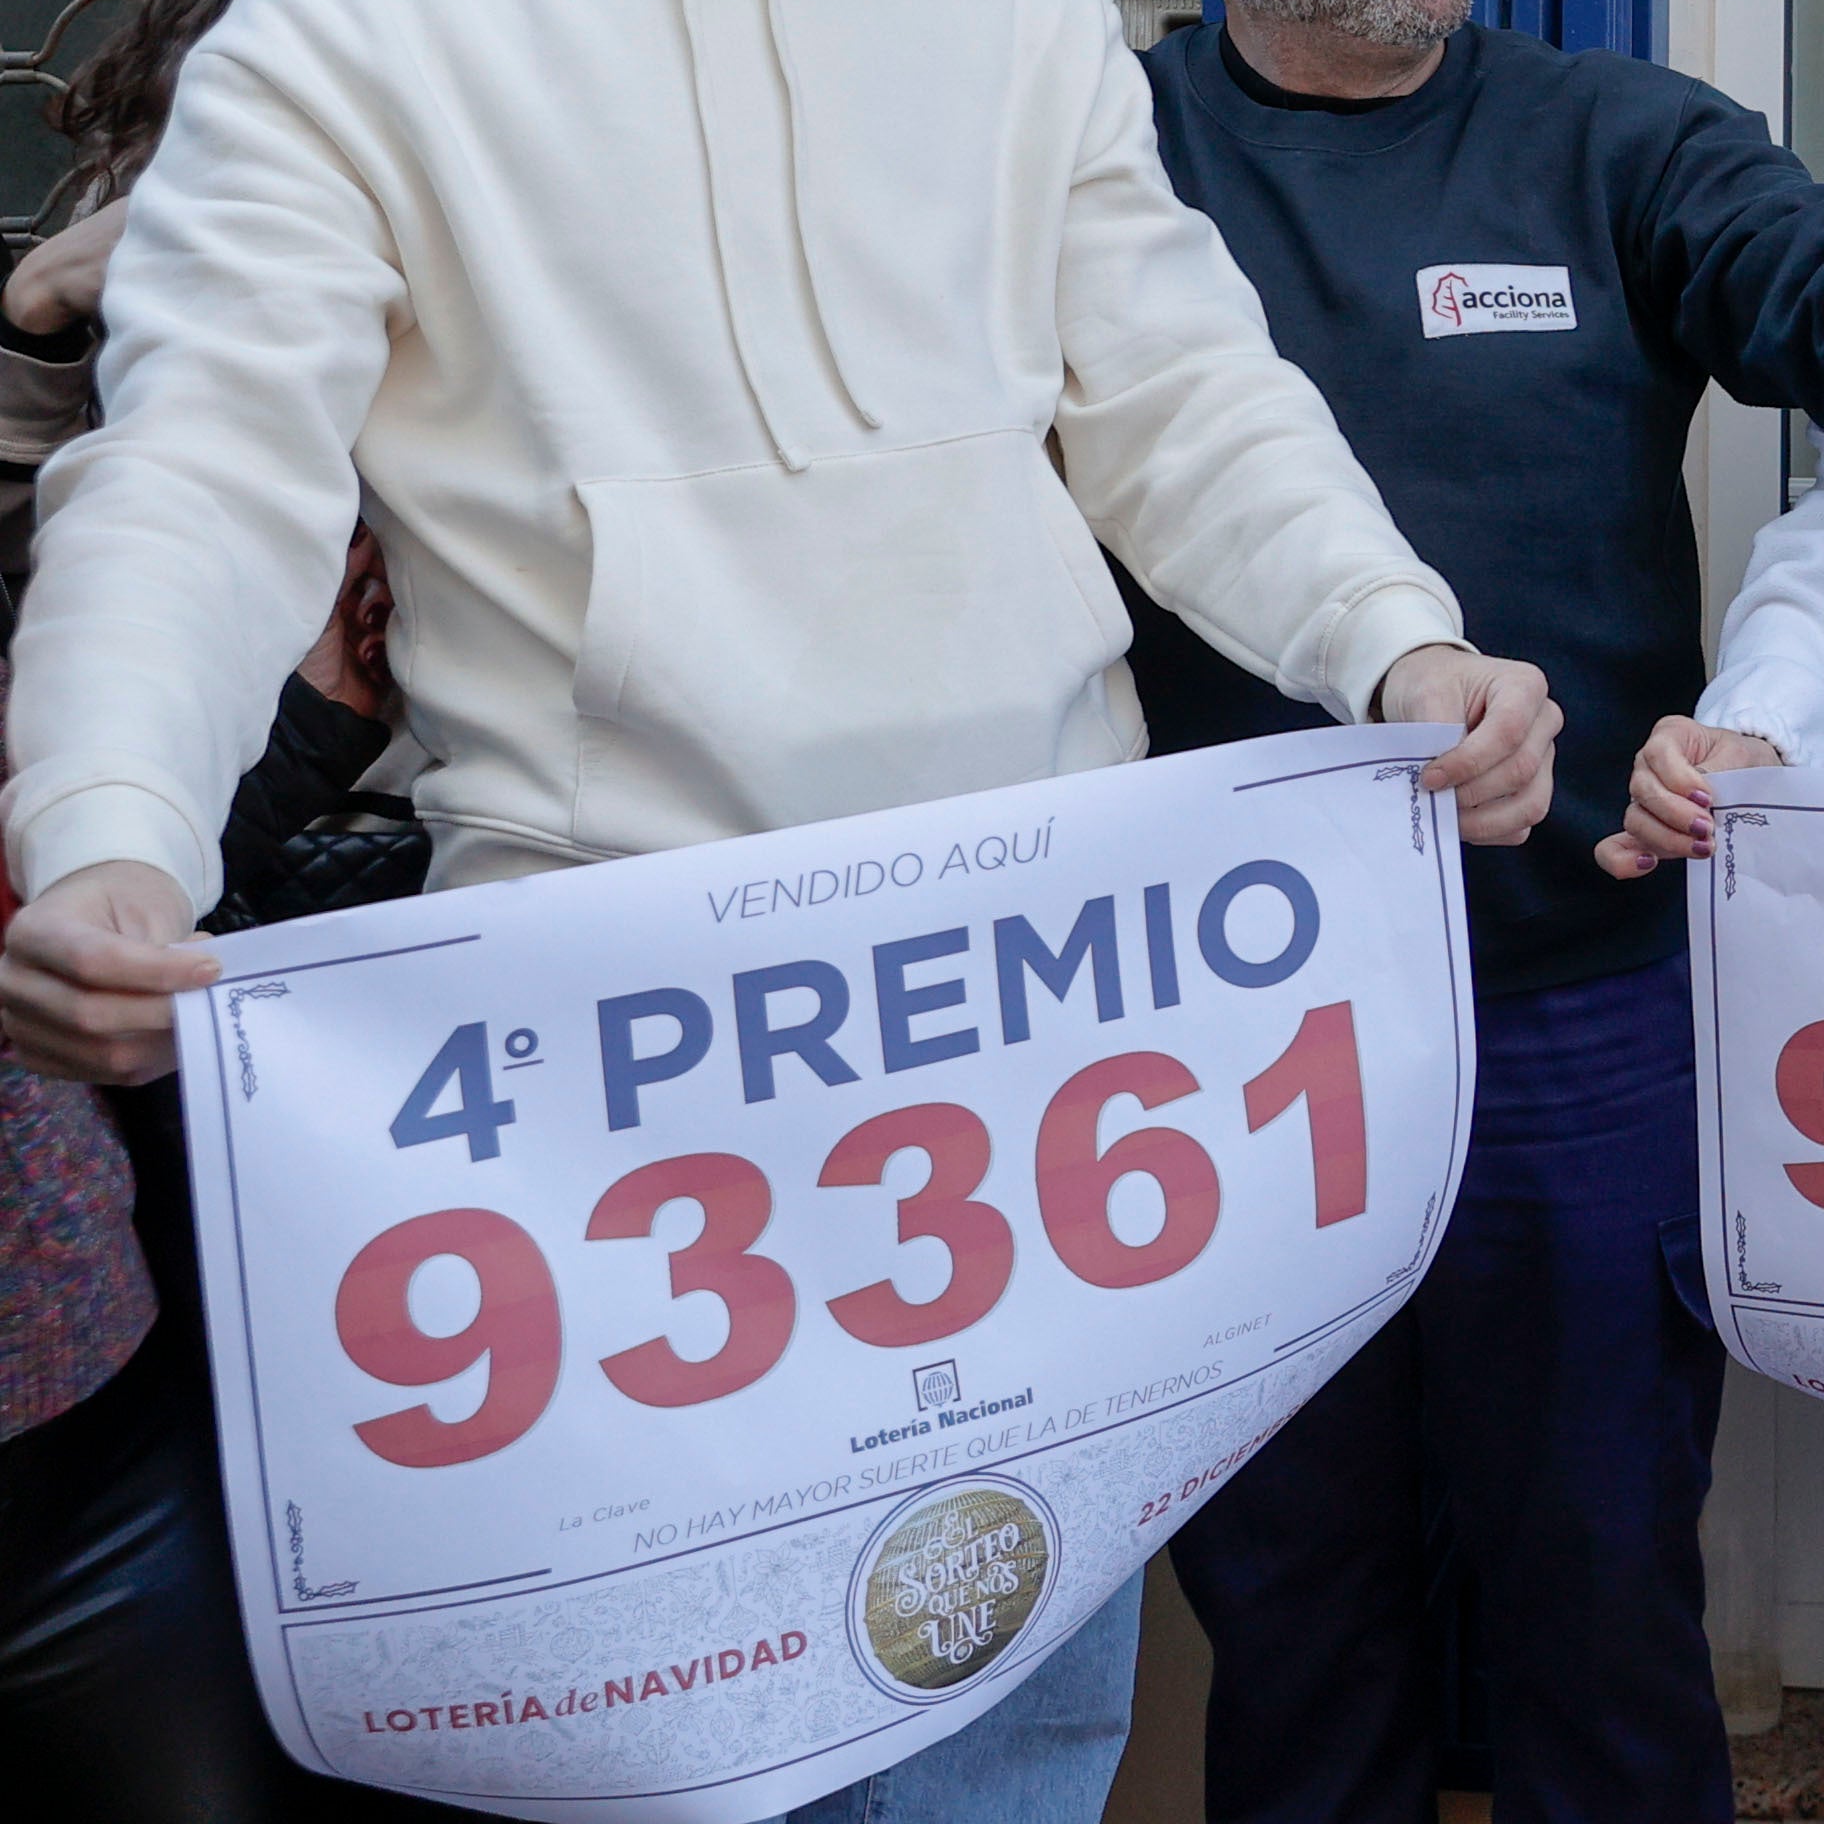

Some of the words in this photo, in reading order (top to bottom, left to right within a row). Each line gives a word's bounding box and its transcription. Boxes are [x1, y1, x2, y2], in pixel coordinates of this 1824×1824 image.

[1462, 285, 1567, 309] acciona
[1493, 310, 1529, 321] Facility
[1531, 309, 1570, 320] Services
[705, 850, 925, 926] VENDIDO
[936, 816, 1058, 884] AQUÍ
[596, 858, 1323, 1133] PREMIO
[332, 999, 1370, 1471] 93361
[1202, 1312, 1274, 1350] ALGINET
[850, 1416, 932, 1455] Lotería
[936, 1386, 1034, 1430] Nacional
[633, 1522, 678, 1554] NO
[685, 1503, 747, 1539] HAY
[750, 1473, 853, 1522] MAYOR
[859, 1444, 961, 1491] SUERTE
[966, 1426, 1023, 1461] QUE
[1025, 1419, 1058, 1446] LA
[1063, 1404, 1100, 1431] DE
[1103, 1361, 1224, 1418] TENERNOS
[558, 1514, 583, 1533] La
[592, 1496, 652, 1524] Clave
[1137, 1491, 1172, 1527] 22
[894, 1522, 1021, 1618] SORTEO
[927, 1585, 972, 1617] QUE
[975, 1560, 1020, 1600] NOS
[916, 1598, 998, 1665] UNE
